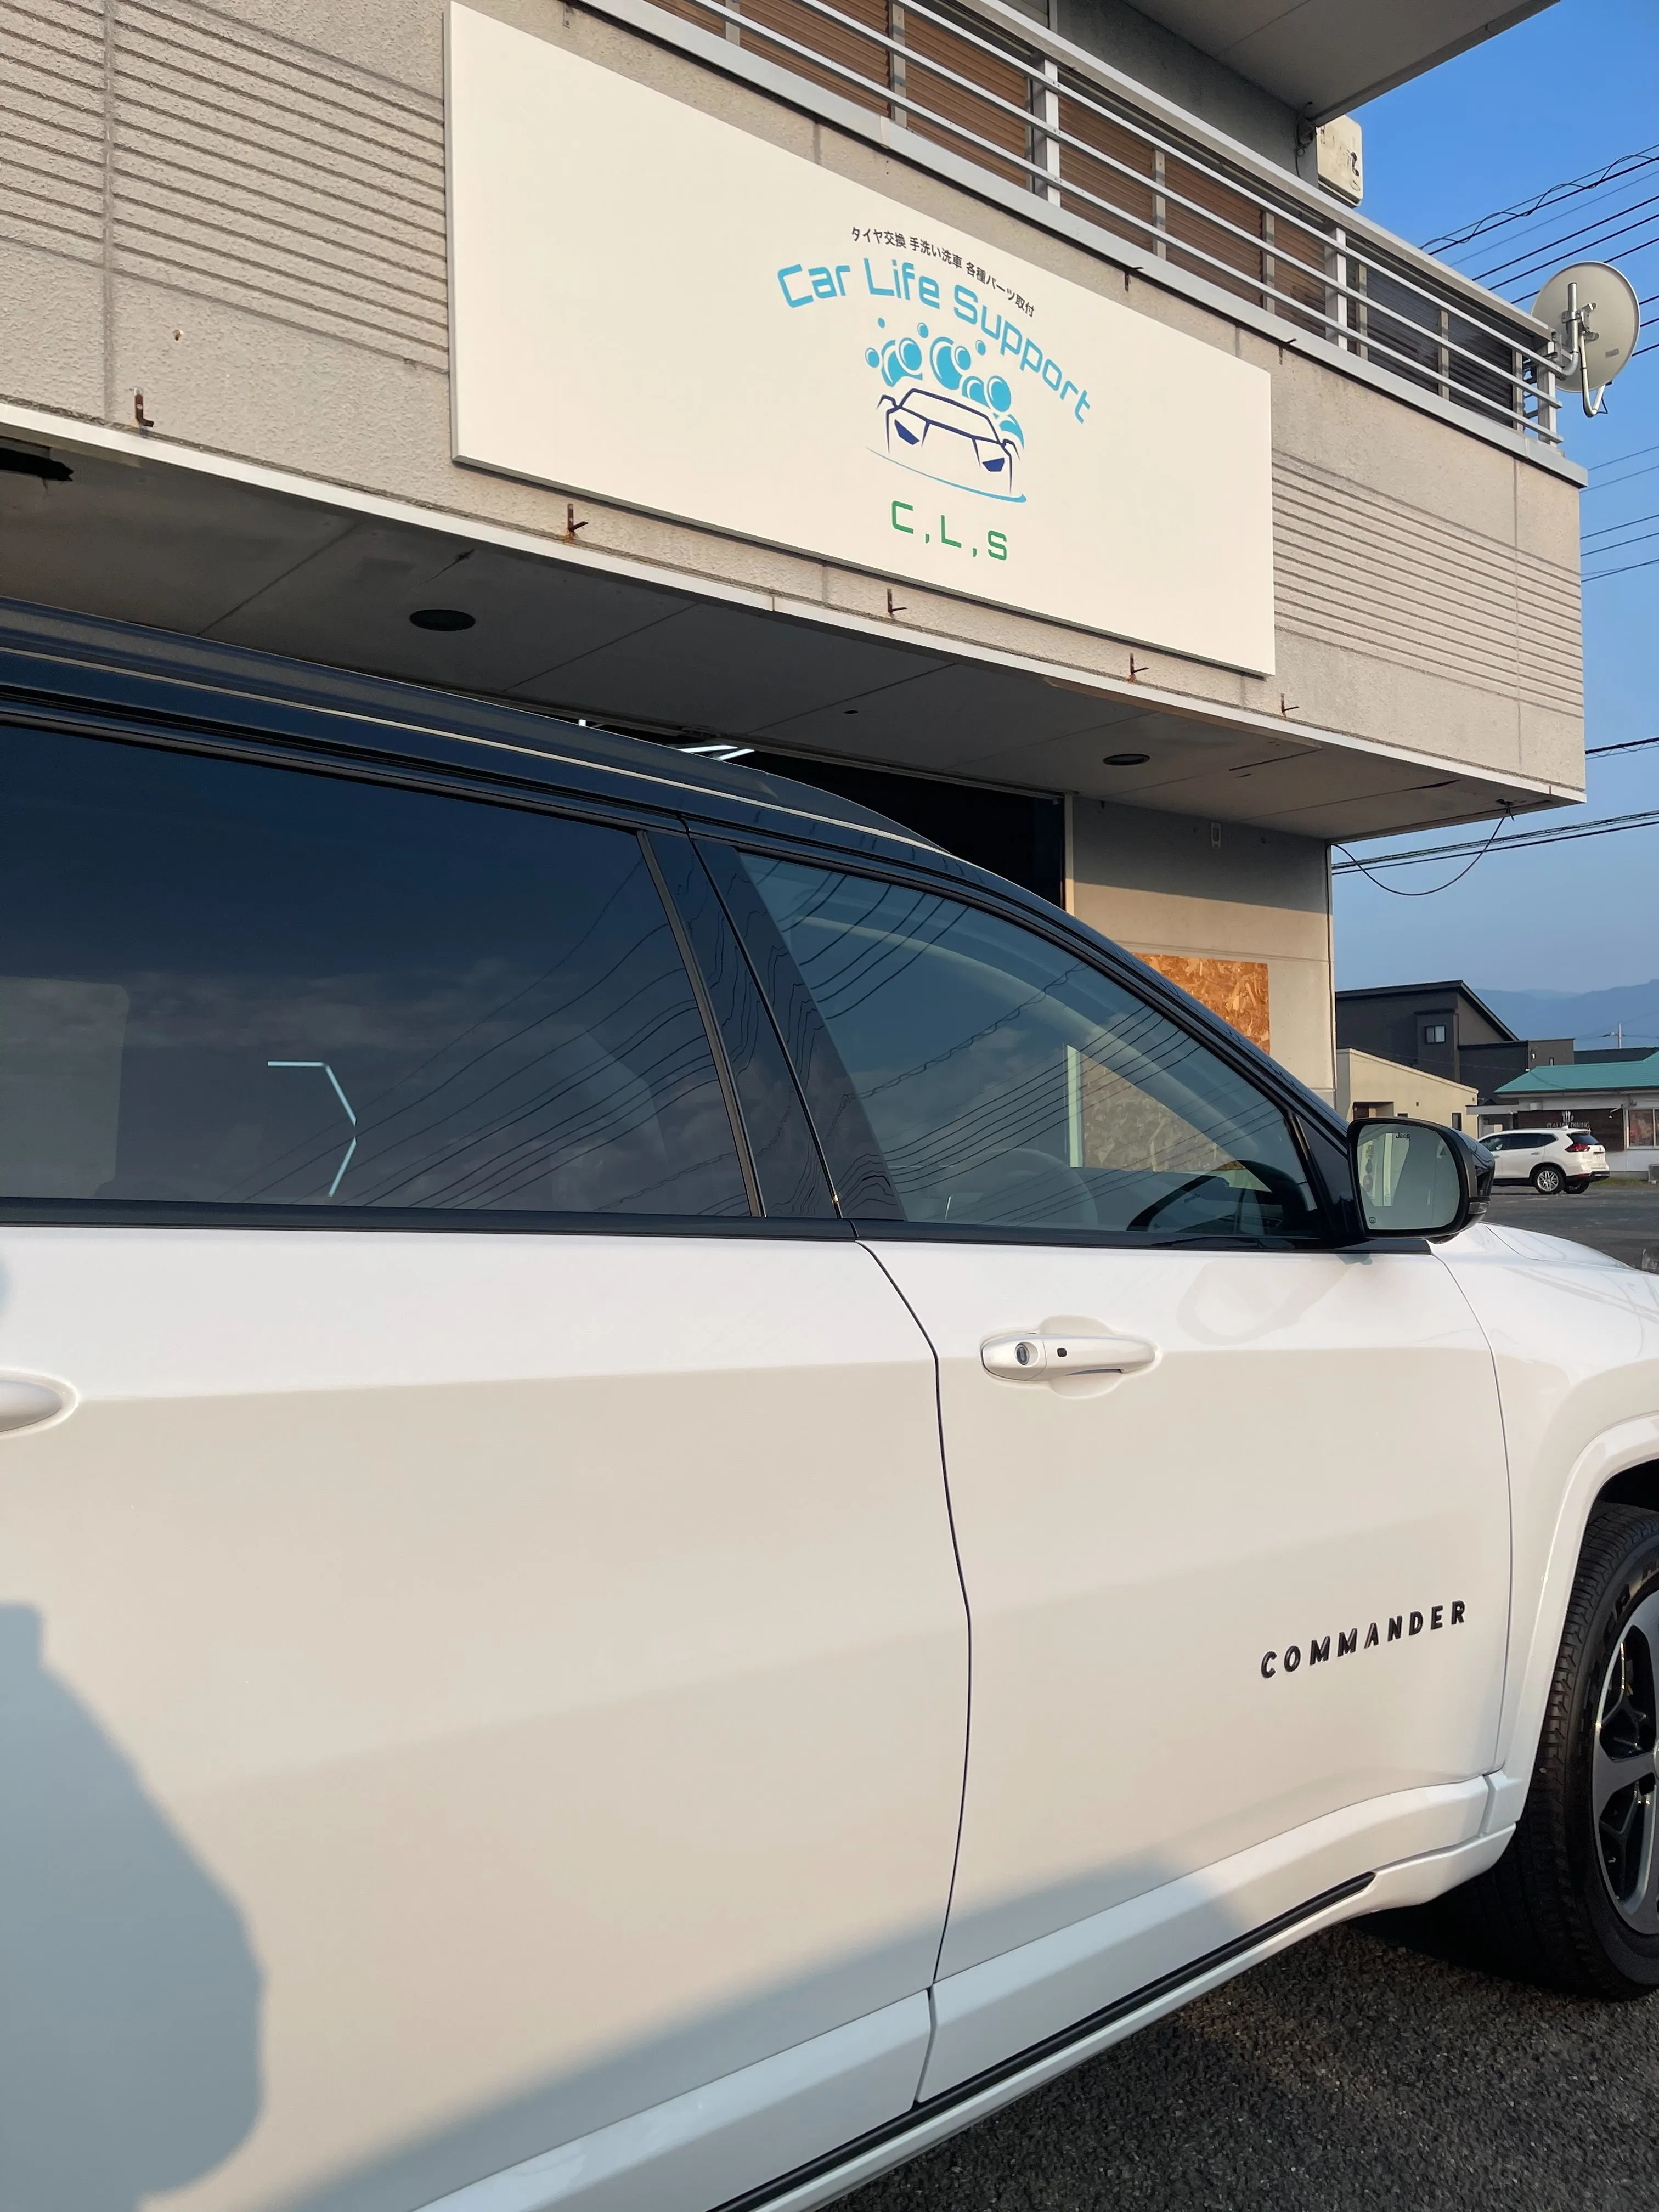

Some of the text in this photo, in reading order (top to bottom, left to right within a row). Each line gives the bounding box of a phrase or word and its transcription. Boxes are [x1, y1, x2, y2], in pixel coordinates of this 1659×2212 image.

[851, 227, 1035, 317] タイヤ交換 手洗い洗車 各種パーツ取付
[777, 258, 1090, 422] Car Life Support
[1396, 1132, 1410, 1140] Jeep
[1261, 1600, 1466, 1679] COMMANDER
